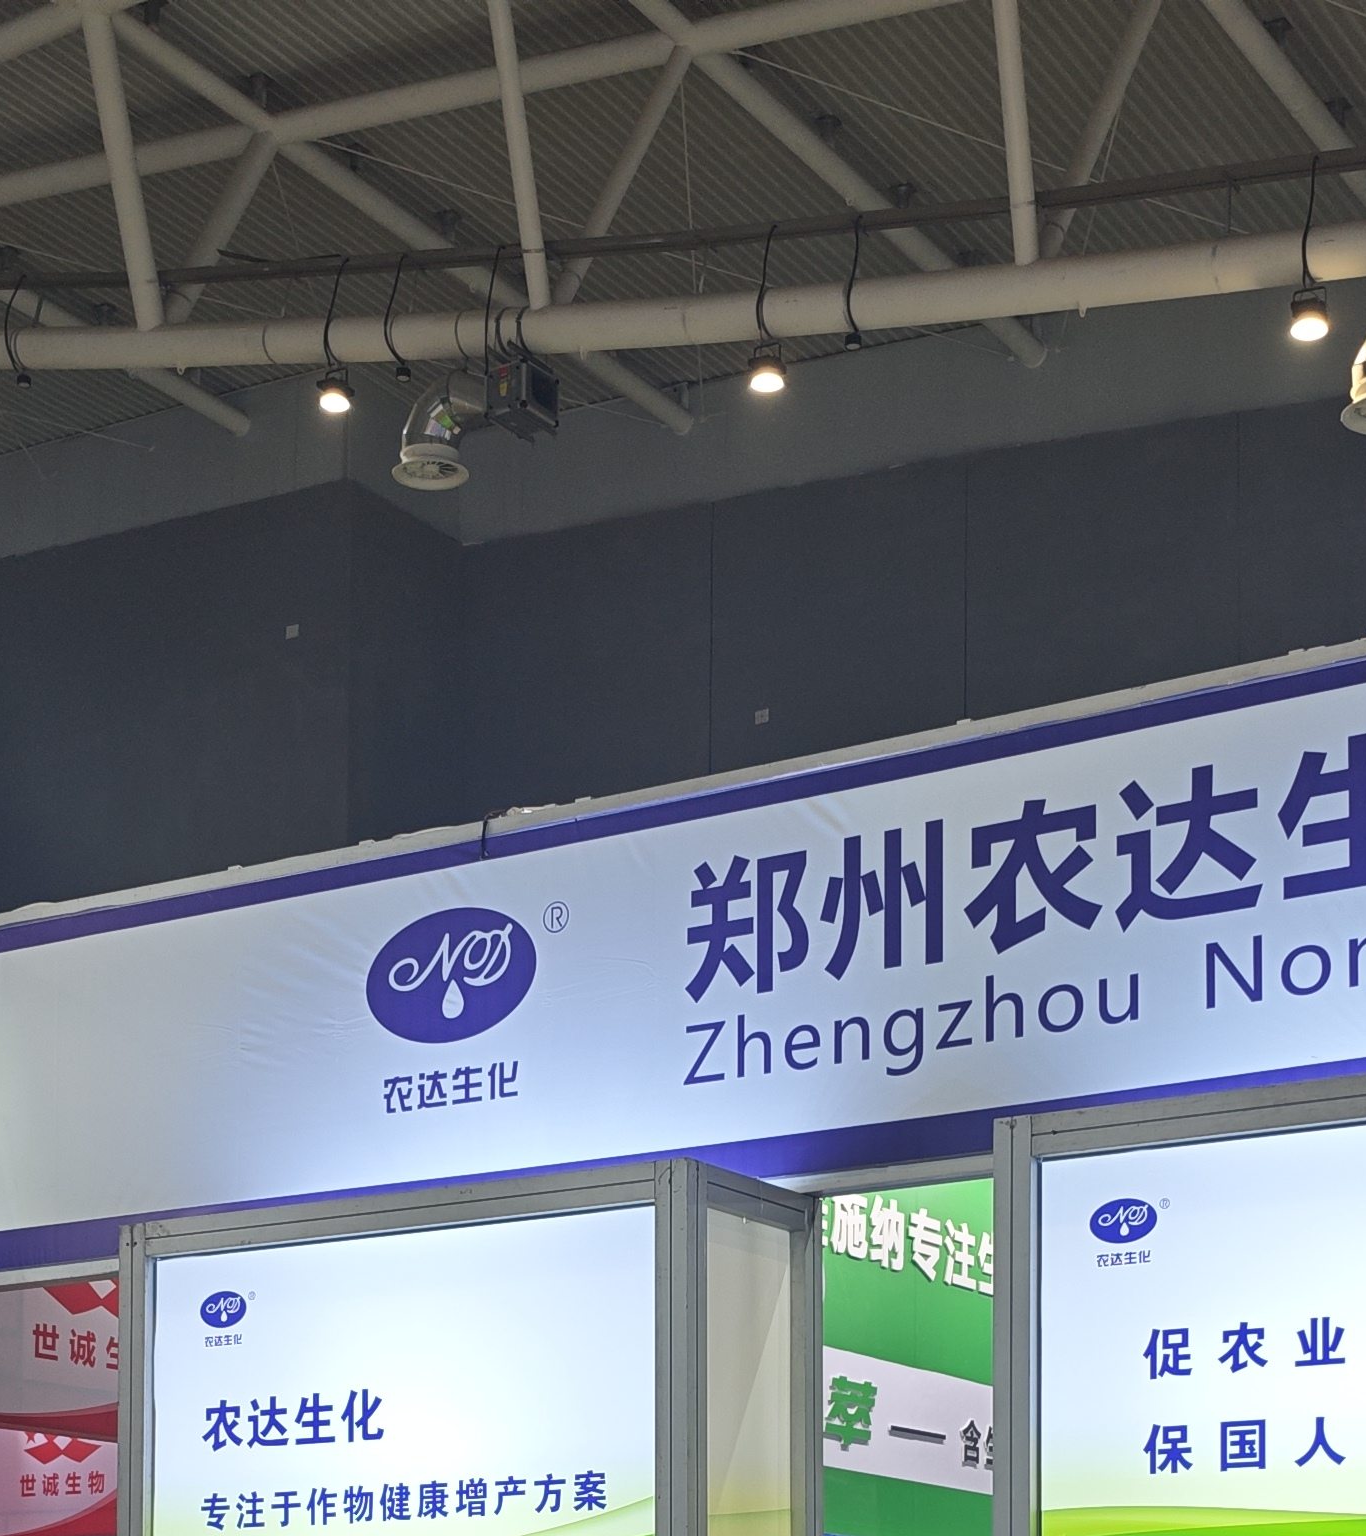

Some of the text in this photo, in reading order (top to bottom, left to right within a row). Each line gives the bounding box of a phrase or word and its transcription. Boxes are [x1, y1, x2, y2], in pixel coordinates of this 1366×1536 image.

[683, 973, 1141, 1087] Zhengzhou
[383, 1061, 519, 1114] 农达生化
[1096, 1250, 1152, 1267] 农达生化
[204, 1334, 243, 1348] 农达生化
[201, 1389, 384, 1452] 农达生化
[20, 1470, 105, 1498] 世诚生物
[201, 1470, 608, 1531] 专注于作物健康增产方案
